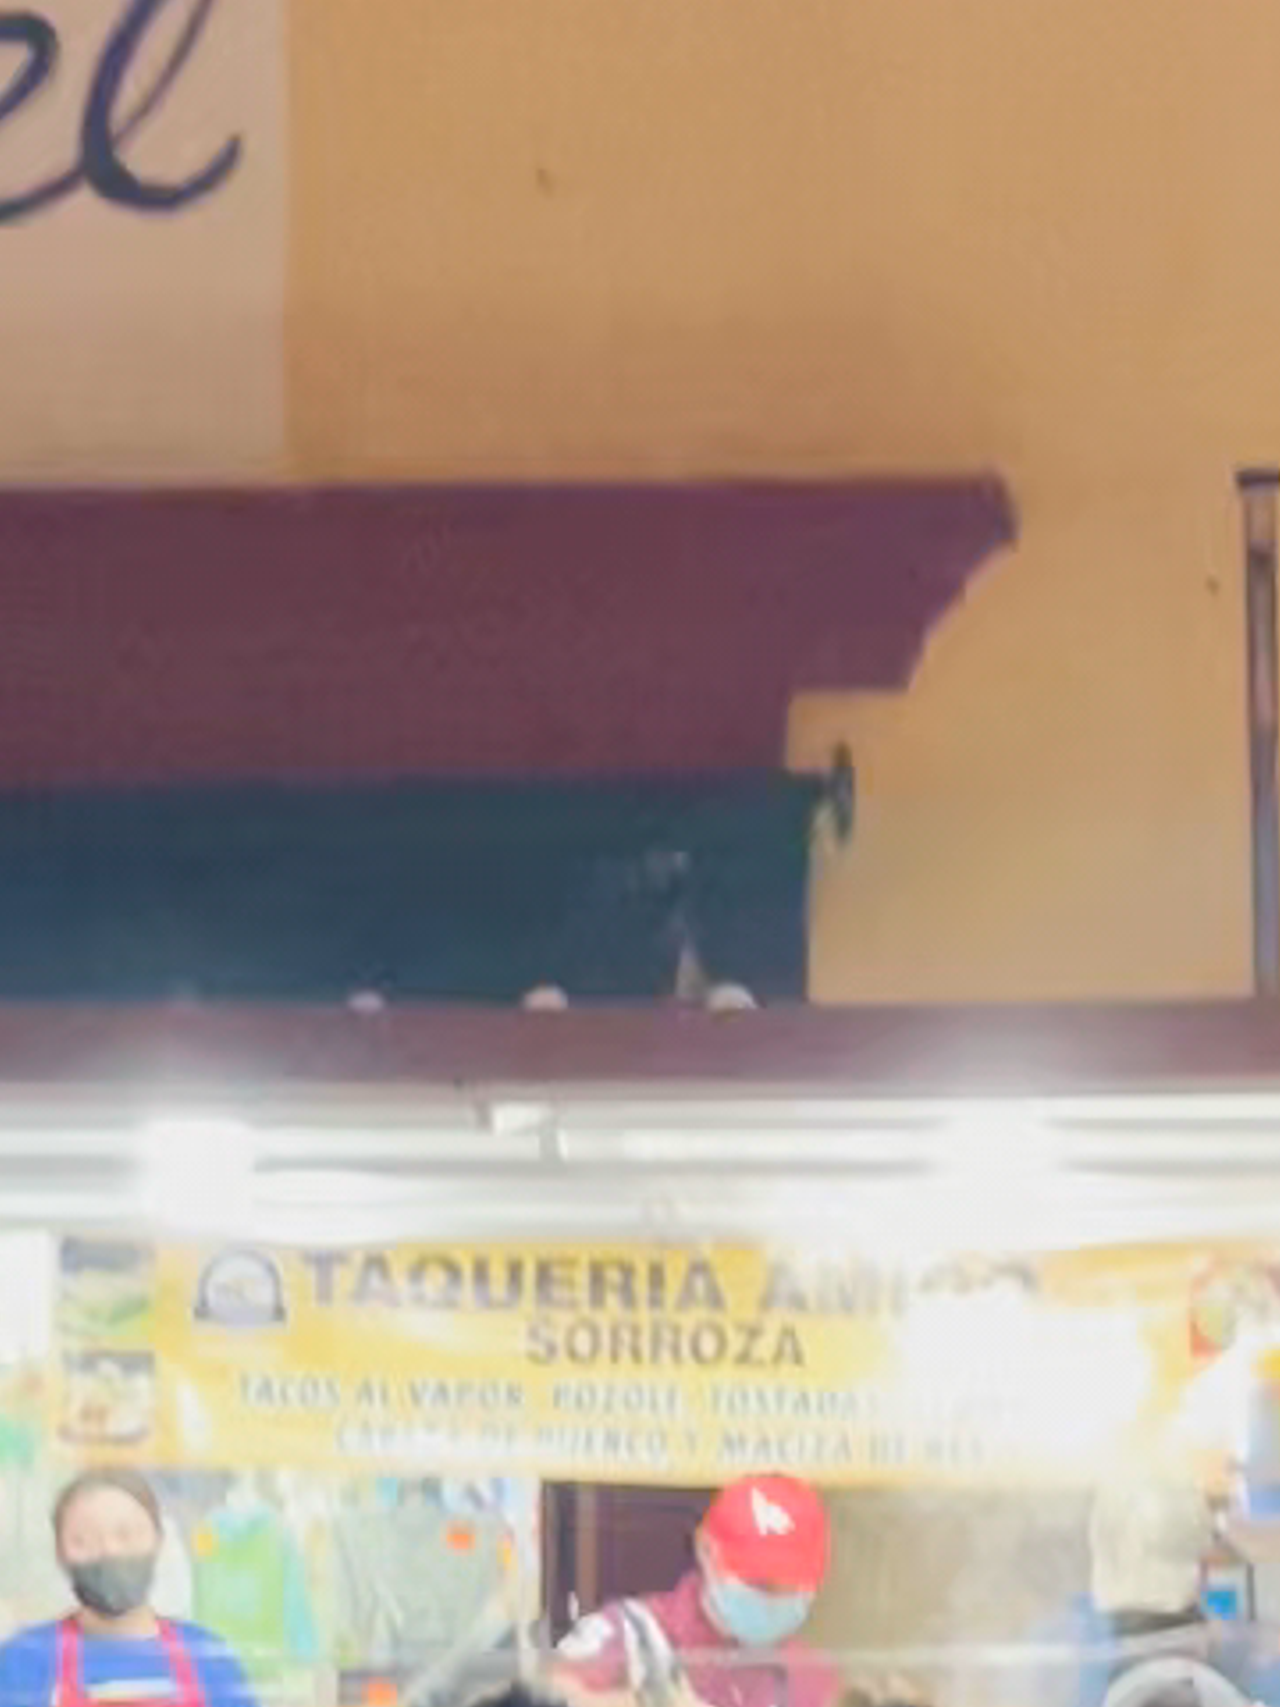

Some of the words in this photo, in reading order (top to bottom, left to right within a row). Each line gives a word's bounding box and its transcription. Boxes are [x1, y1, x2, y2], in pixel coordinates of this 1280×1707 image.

[303, 1250, 726, 1311] TAQUERIA
[526, 1319, 805, 1366] SORROZA
[240, 1373, 340, 1407] TACOS
[357, 1377, 395, 1407] AL
